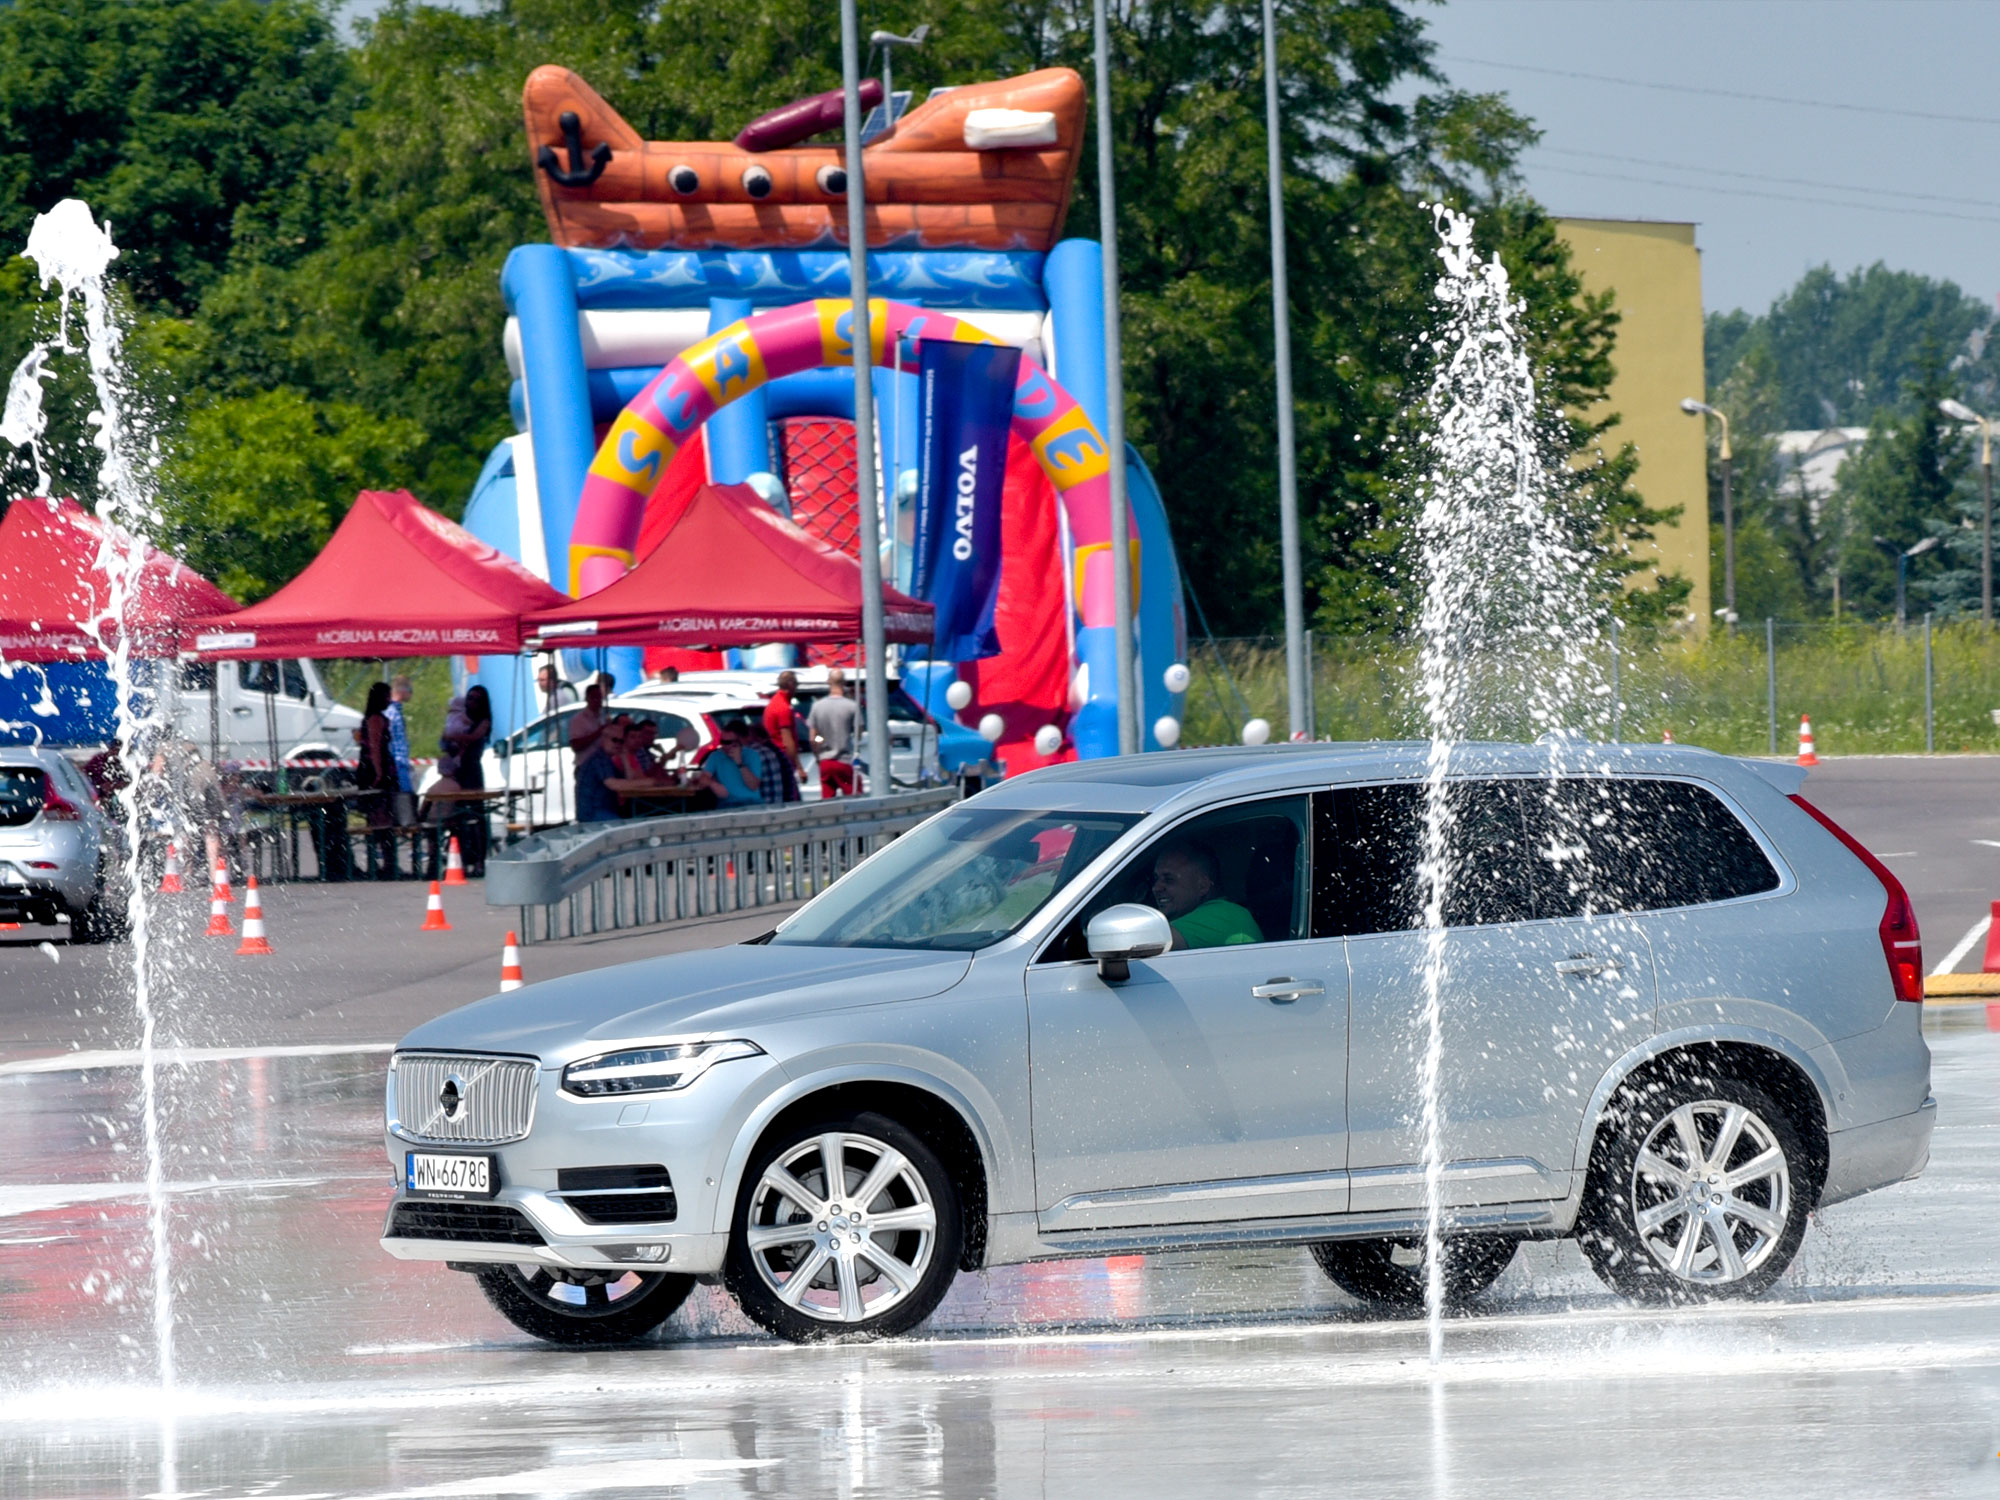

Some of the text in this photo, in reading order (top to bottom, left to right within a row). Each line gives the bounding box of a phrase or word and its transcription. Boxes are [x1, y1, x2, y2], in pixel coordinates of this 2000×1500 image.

[835, 309, 1106, 471] SLDE
[953, 444, 978, 561] VOLVO
[317, 628, 499, 644] MOBILNA KARCZMA LUBELSKA
[657, 618, 716, 632] MOBILNA
[719, 617, 779, 631] KARCZMA
